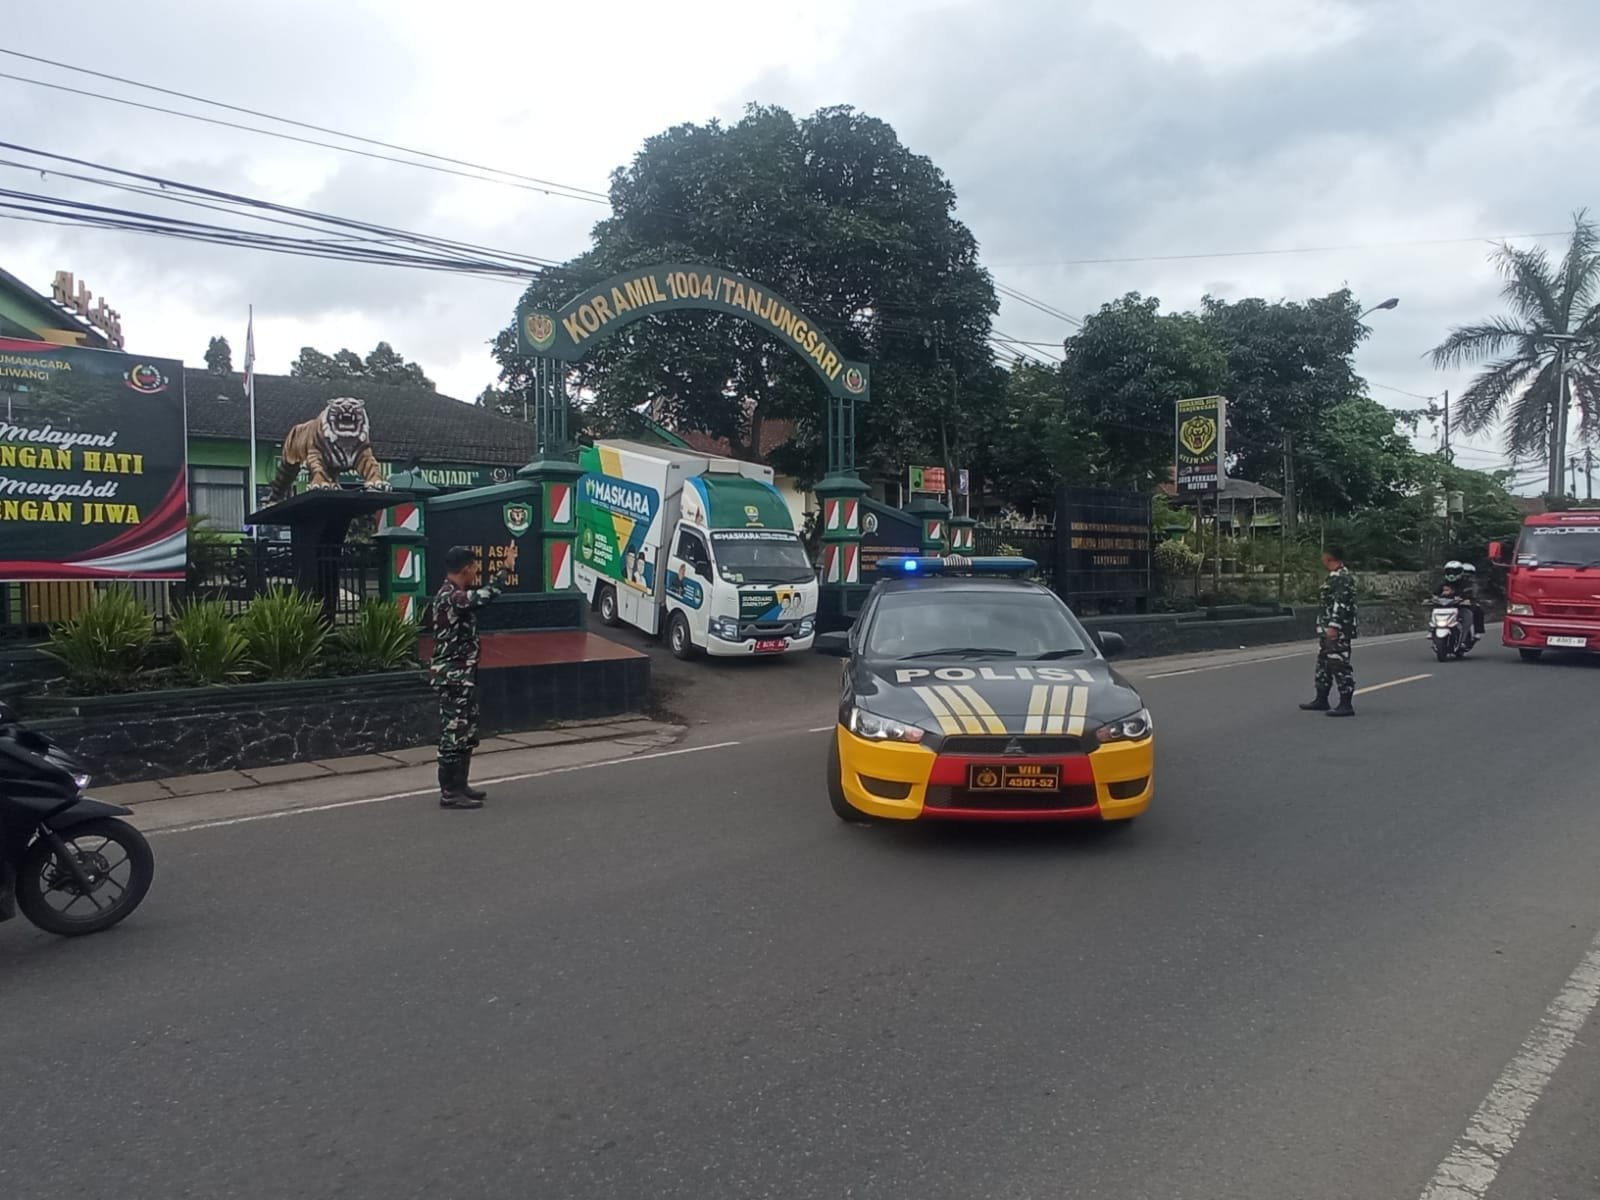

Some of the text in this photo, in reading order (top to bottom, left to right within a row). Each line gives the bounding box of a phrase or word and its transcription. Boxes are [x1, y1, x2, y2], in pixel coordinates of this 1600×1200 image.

[562, 271, 843, 382] KORAMIL 1004/TANJUNGSARI
[0, 422, 117, 449] Melayani
[83, 450, 144, 475] HATI
[0, 476, 118, 501] Mengabdi
[595, 480, 650, 516] MASKARA
[0, 500, 140, 525] NGAN JIWA
[896, 667, 1095, 683] POLISI
[1018, 765, 1041, 775] VIII
